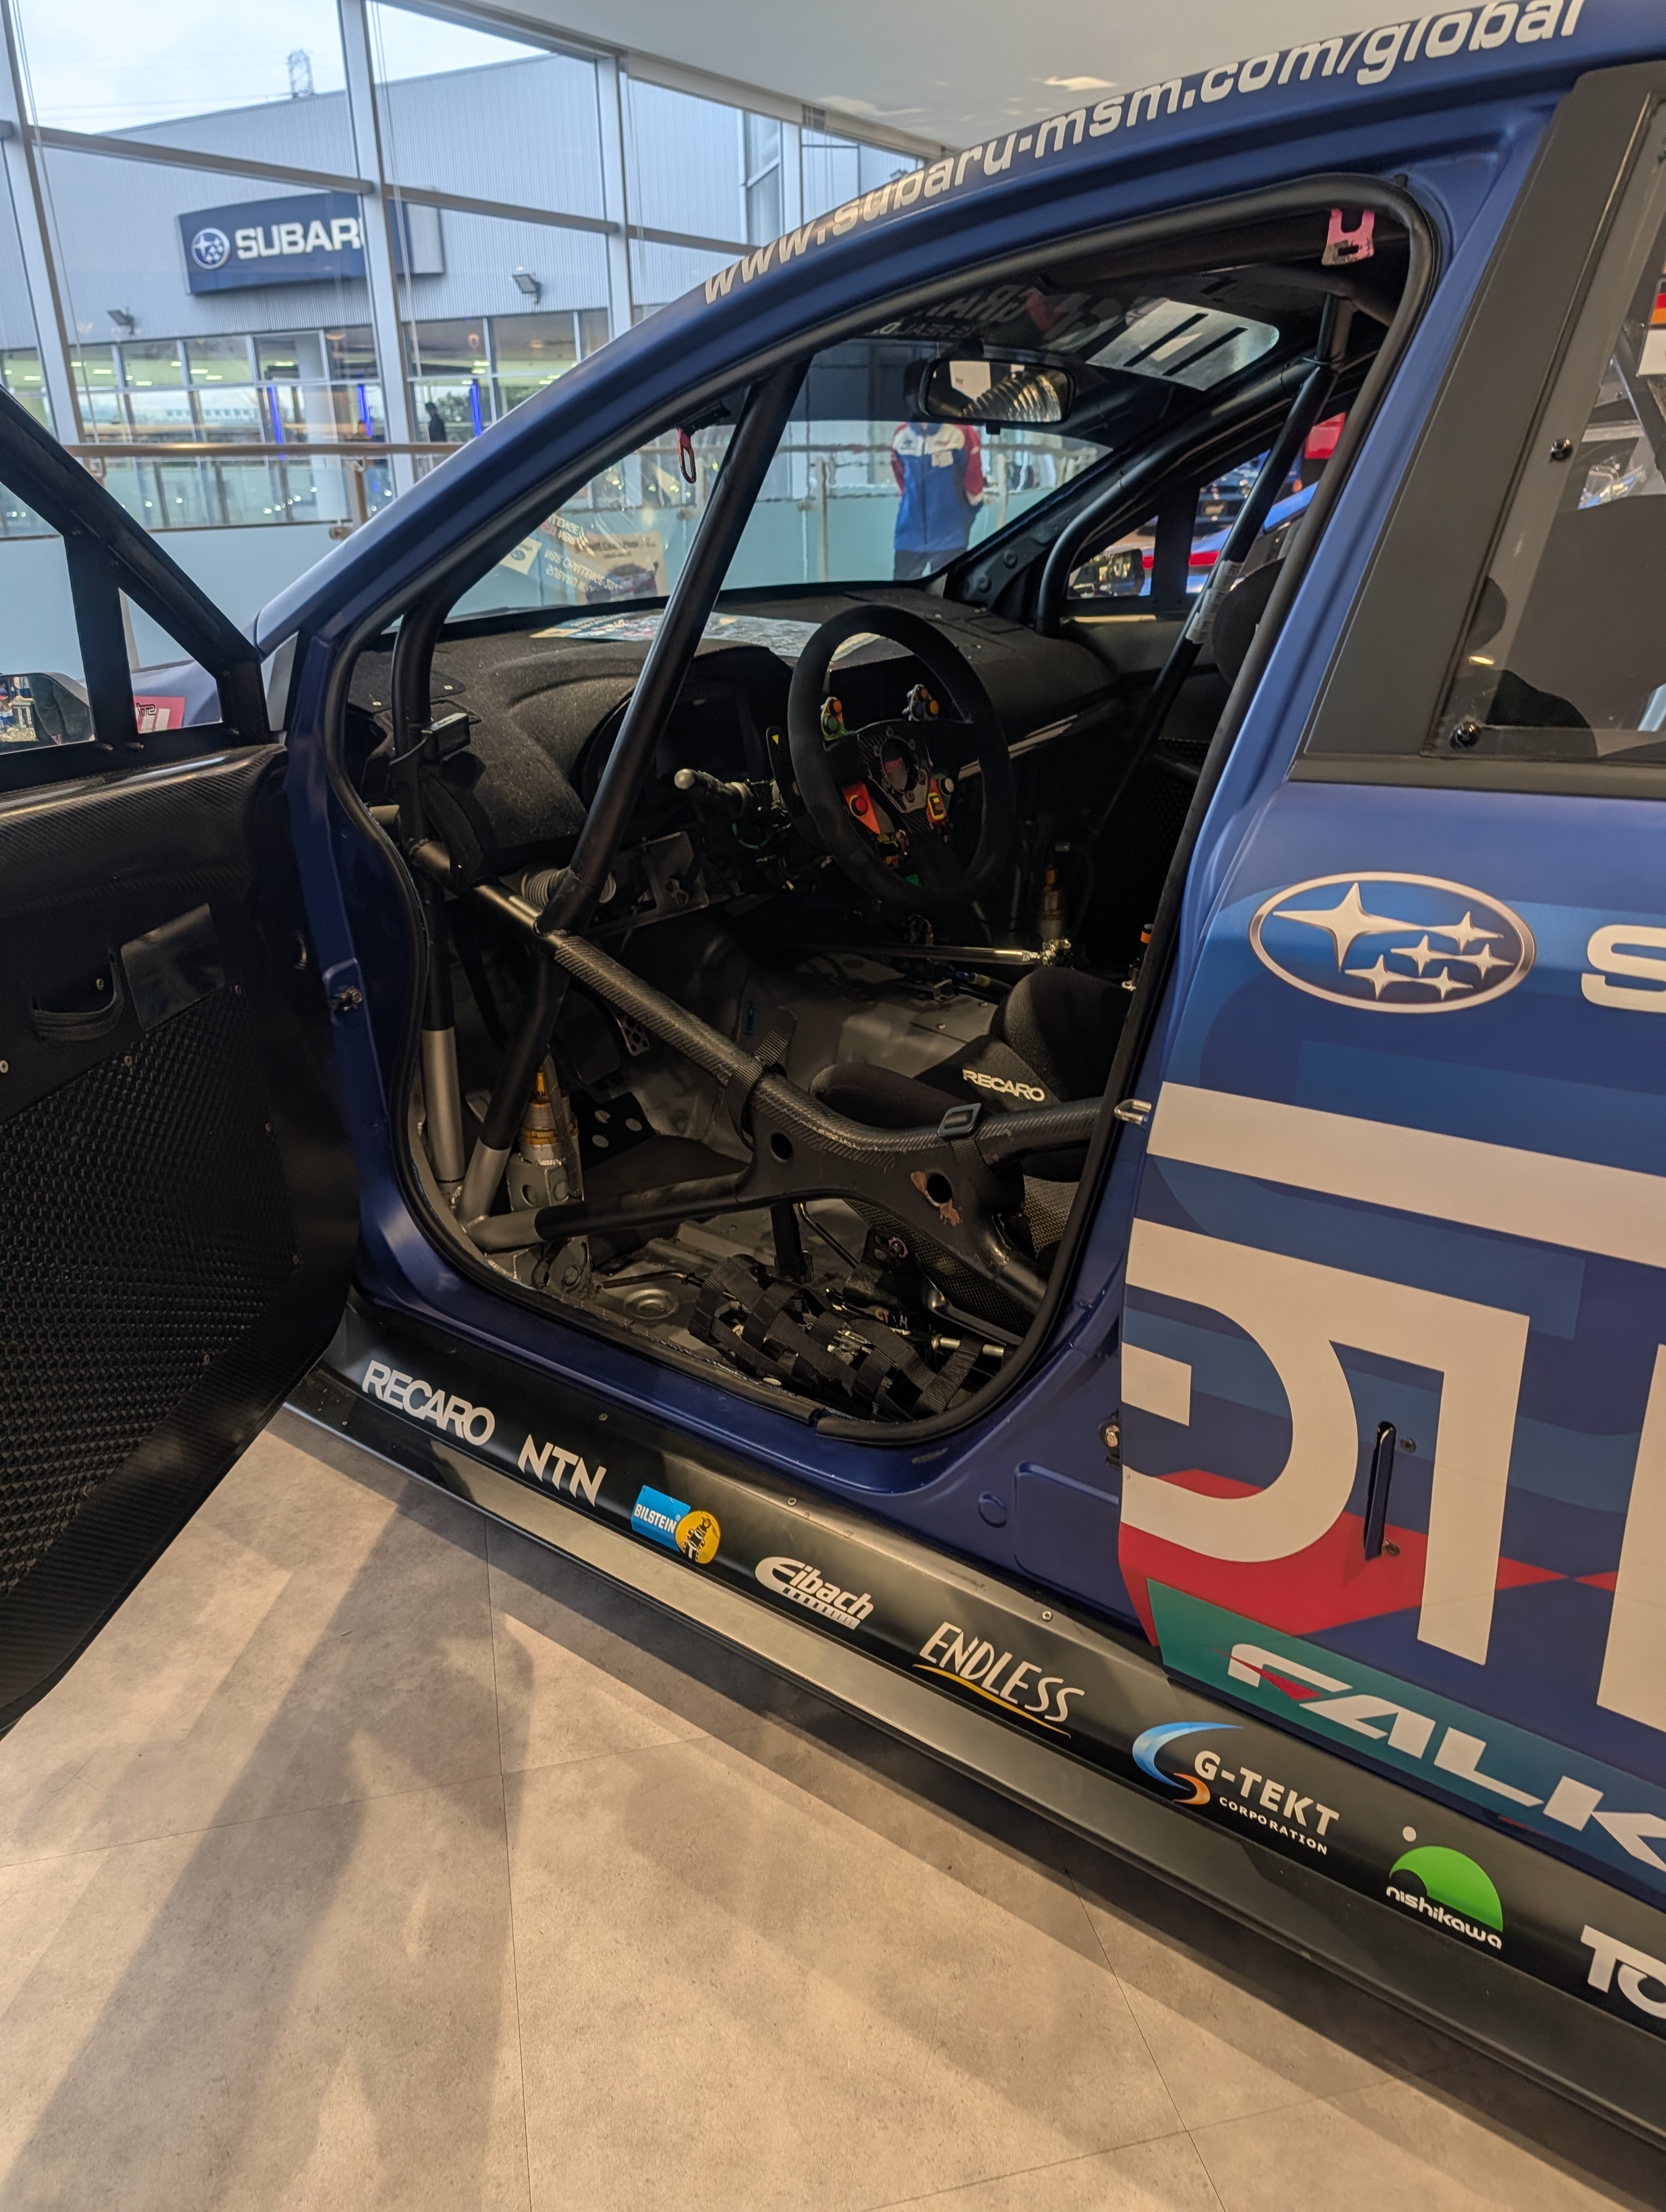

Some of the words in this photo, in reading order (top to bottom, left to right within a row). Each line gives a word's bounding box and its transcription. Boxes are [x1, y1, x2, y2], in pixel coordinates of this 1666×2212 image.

[704, 0, 1585, 304] www.subaru-msm.com/global
[234, 217, 365, 260] SUBAR
[962, 1069, 1045, 1102] RECARO
[362, 1360, 495, 1446] RECARO
[518, 1434, 606, 1506] NTN
[633, 1502, 677, 1534] BILSTEIN
[754, 1555, 874, 1629] Eibach
[919, 1622, 1085, 1723] ENDLESS
[1194, 1750, 1340, 1838] G-TEKT
[1219, 1796, 1329, 1856] CORPORATION
[1386, 1886, 1502, 1950] nishikawa
